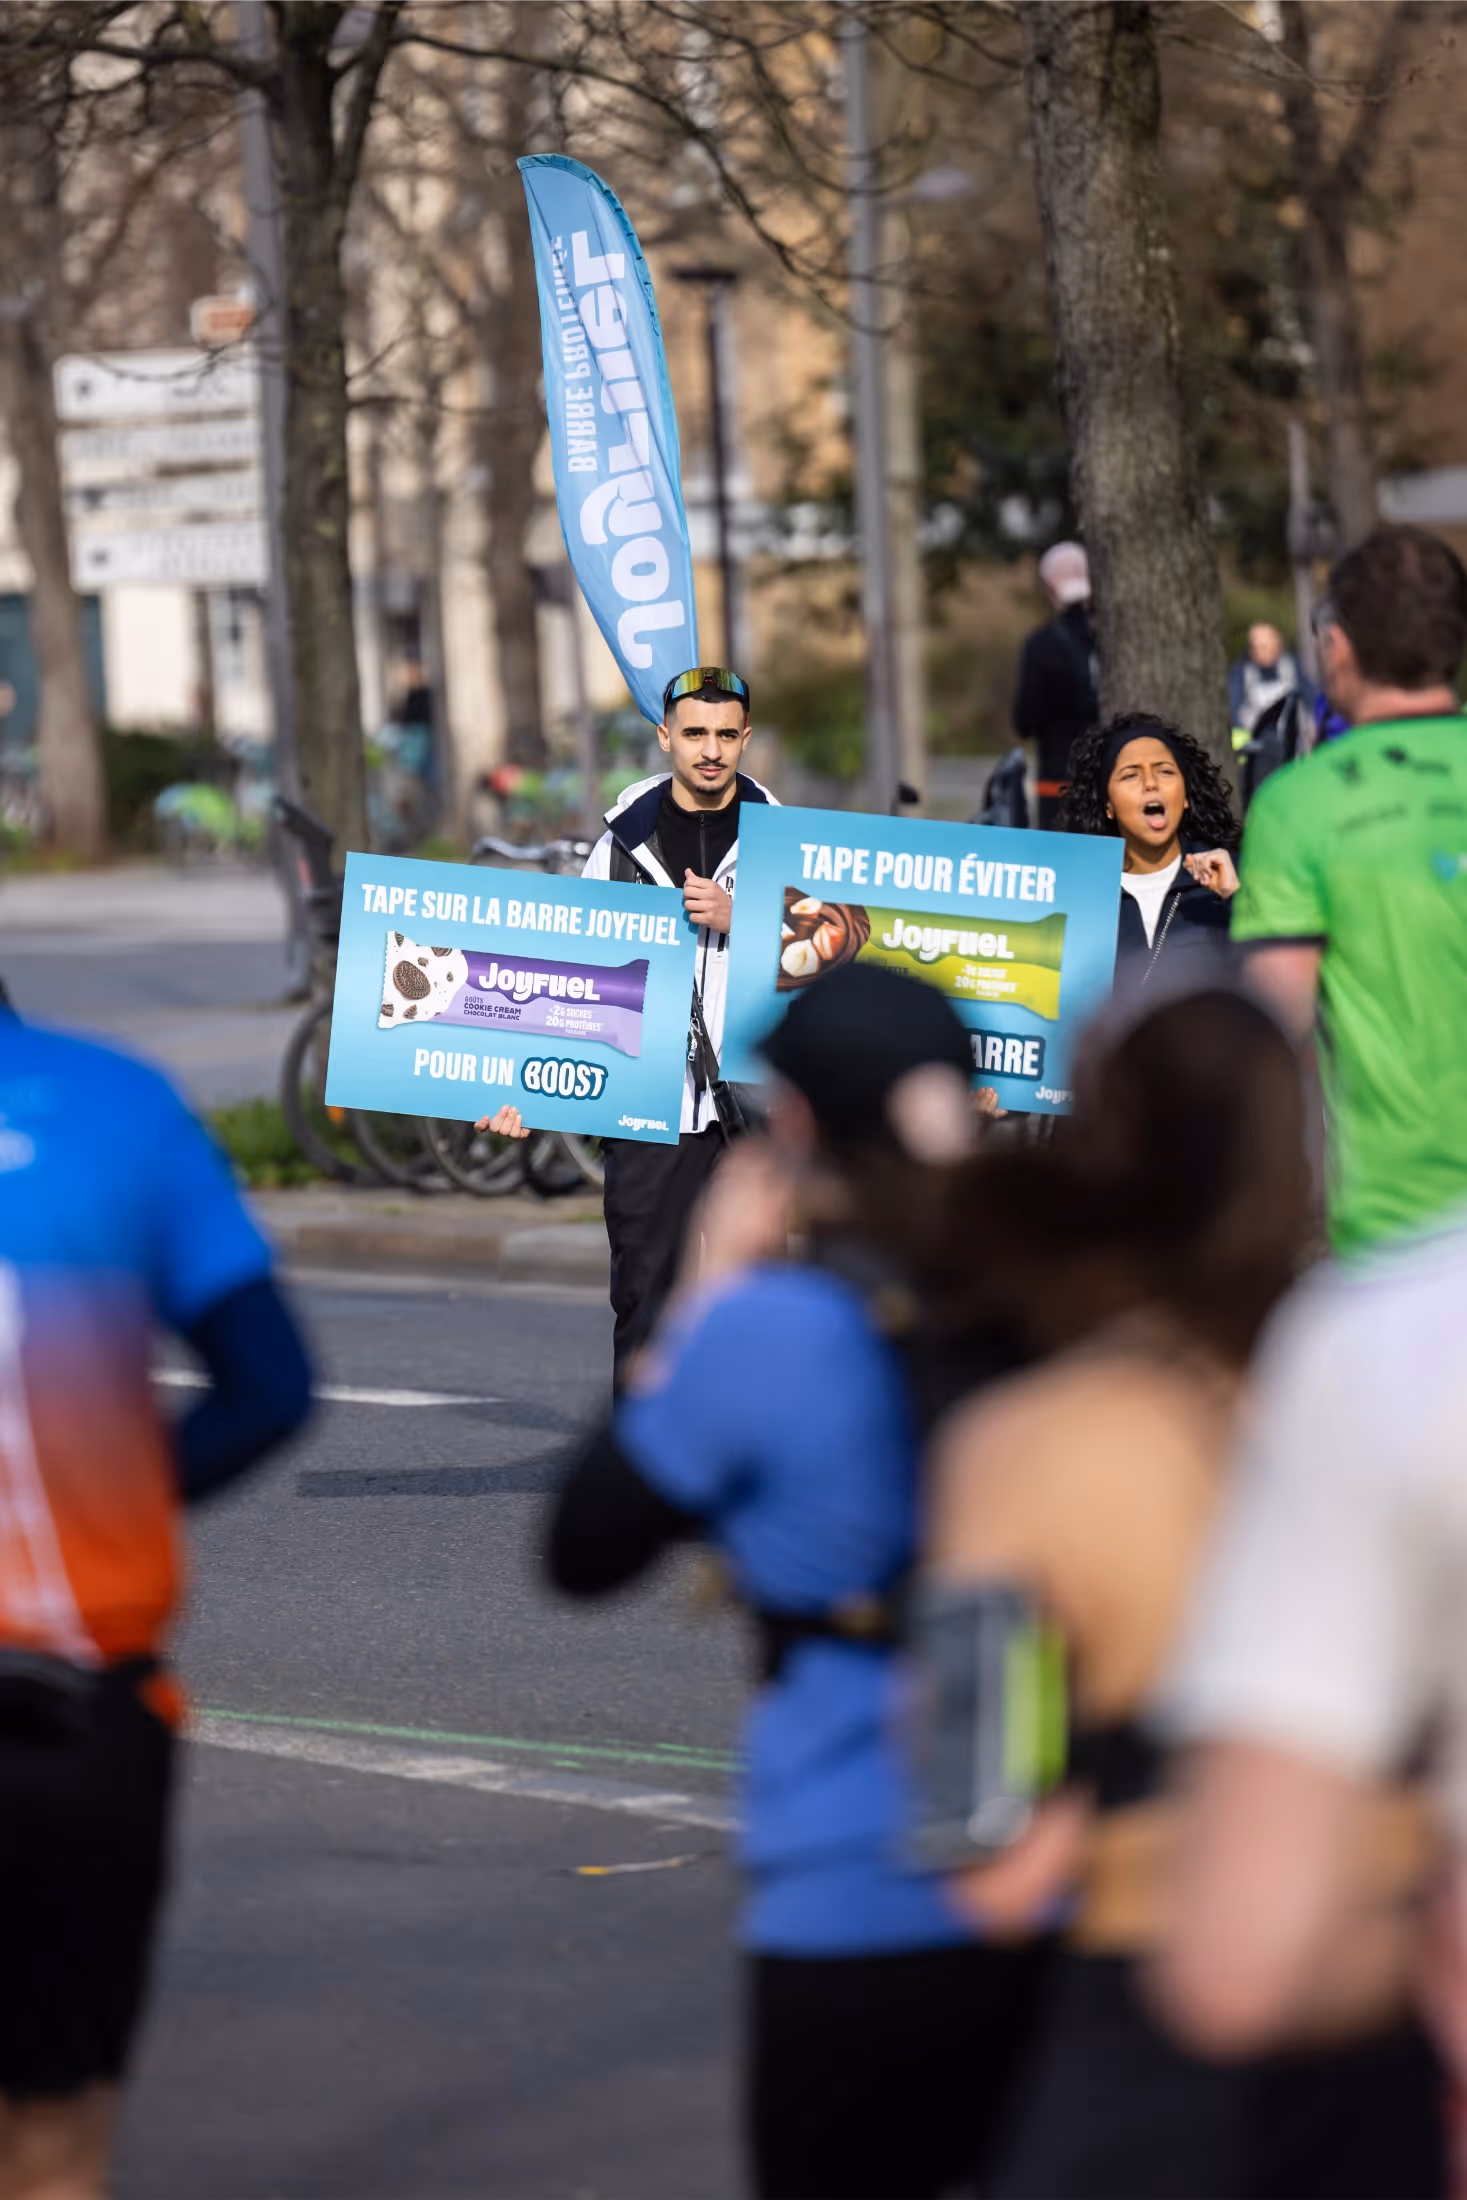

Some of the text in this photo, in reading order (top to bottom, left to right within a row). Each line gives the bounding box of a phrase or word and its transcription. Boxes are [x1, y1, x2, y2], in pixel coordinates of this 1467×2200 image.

[800, 843, 1057, 903] TAPE POUR ÉVITER
[361, 883, 681, 946] TAPE SUR LA BARRE JOYFUEL
[463, 1009, 520, 1021] CHOCOLAT BLANC
[464, 1002, 521, 1015] COOKIE CREAM
[413, 1047, 605, 1097] POUR UN BOOST
[969, 1033, 1040, 1076] ARRE
